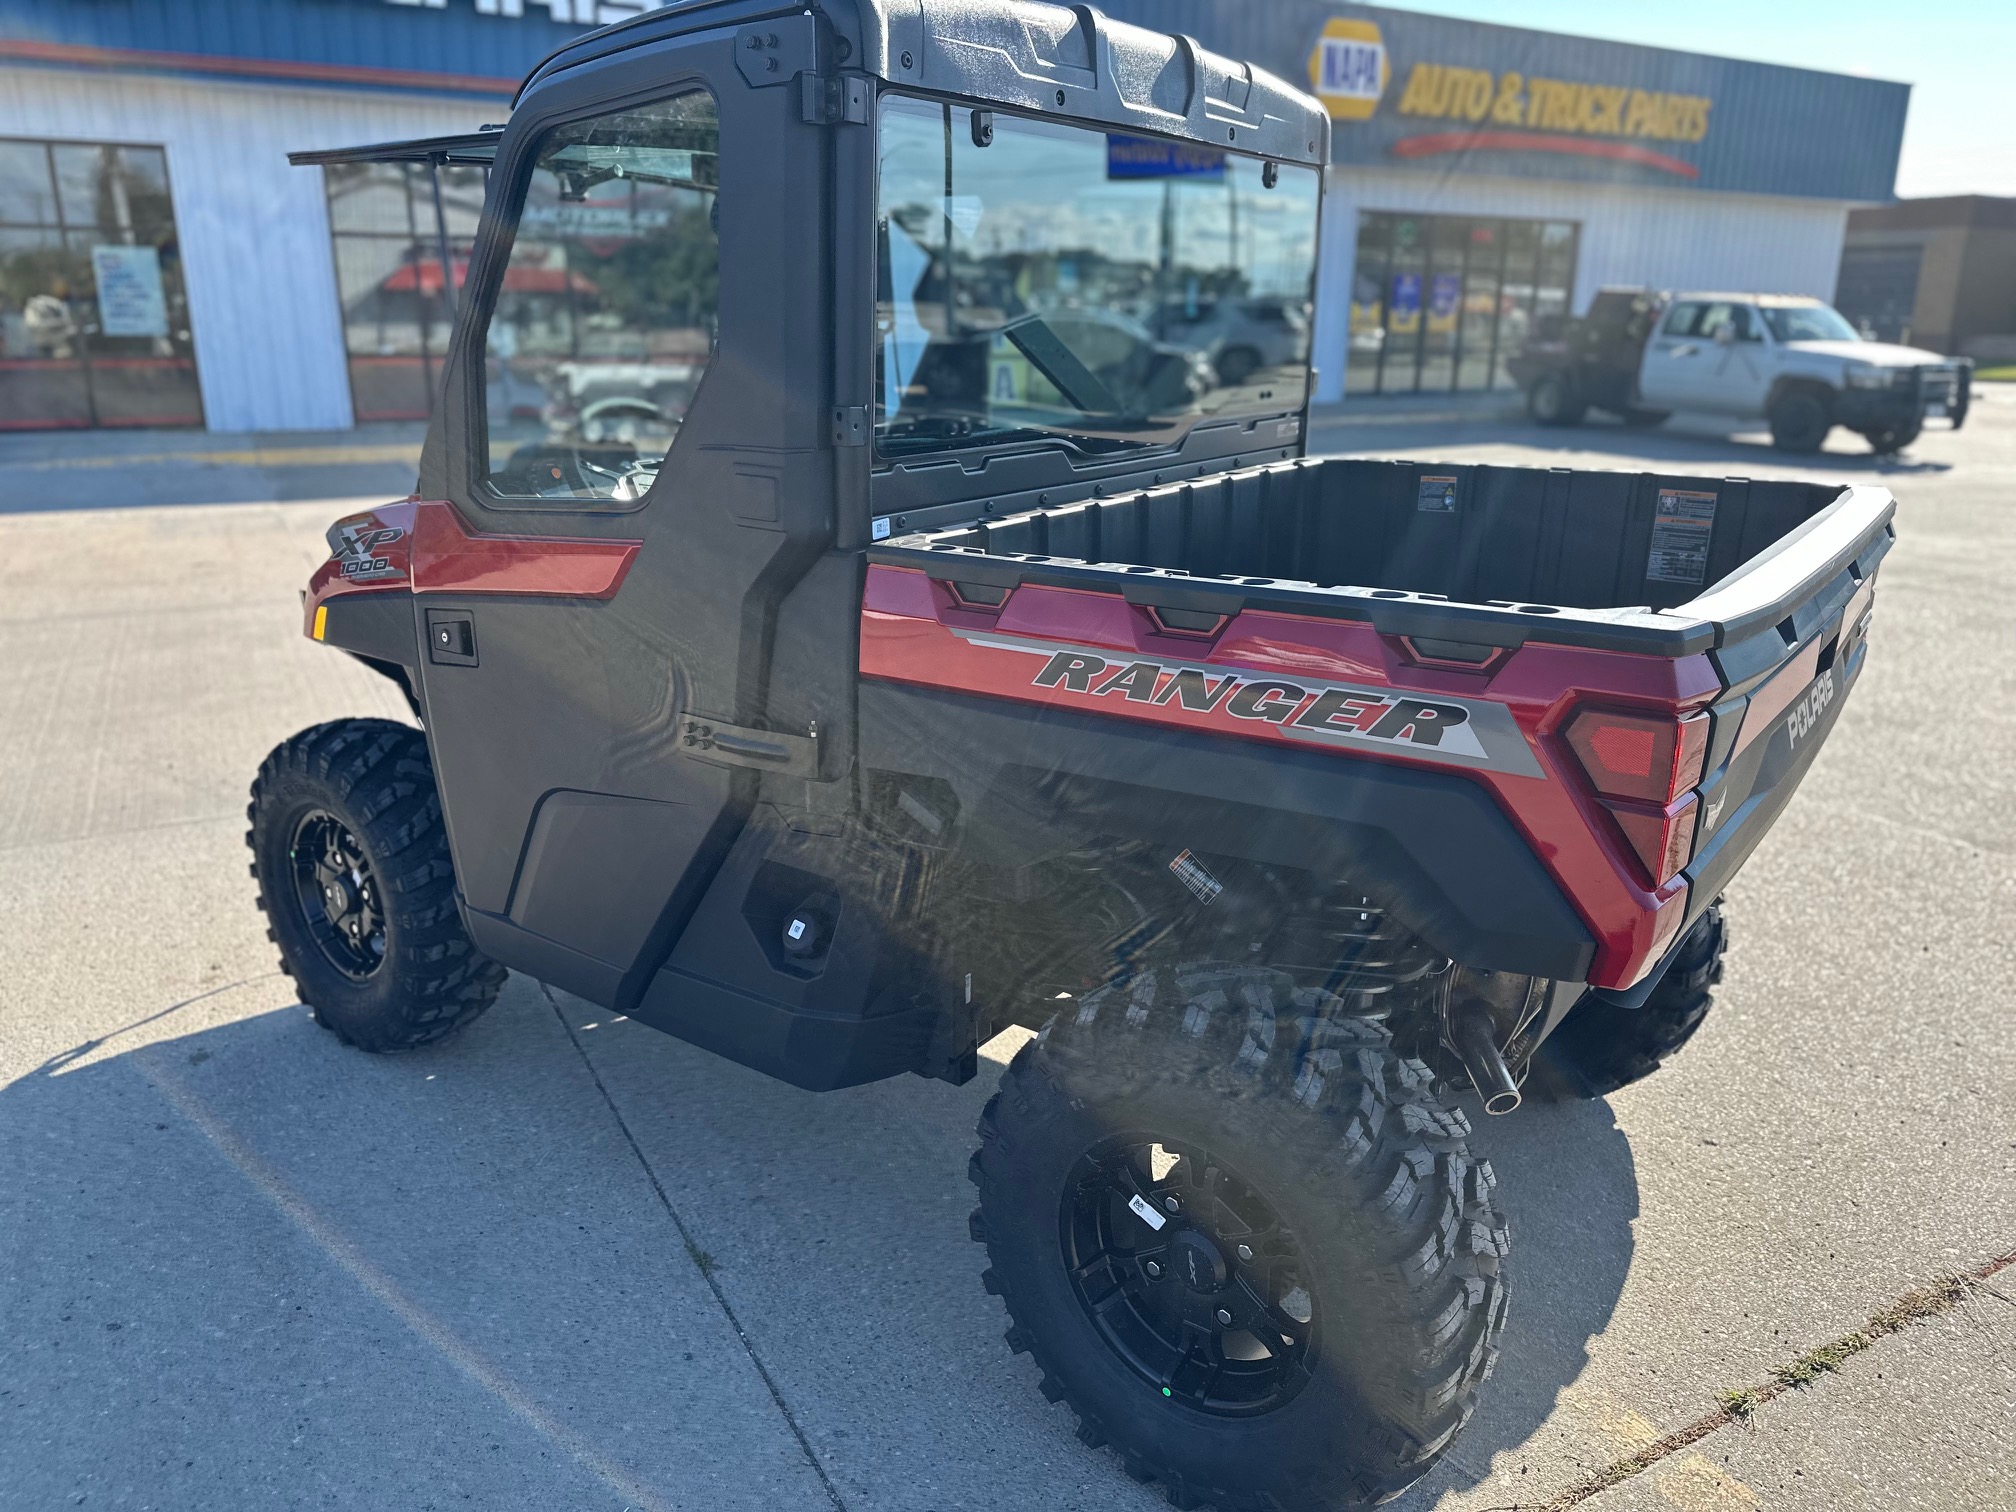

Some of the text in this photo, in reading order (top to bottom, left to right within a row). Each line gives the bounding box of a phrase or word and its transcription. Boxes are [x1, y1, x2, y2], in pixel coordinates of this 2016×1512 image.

[1322, 42, 1378, 93] NAPA
[1398, 62, 1711, 142] AUTO & TRUCK PARTS
[331, 527, 403, 559] XP
[340, 557, 389, 576] 1000
[1031, 650, 1470, 747] RANGER
[1787, 668, 1834, 750] POLARIS
